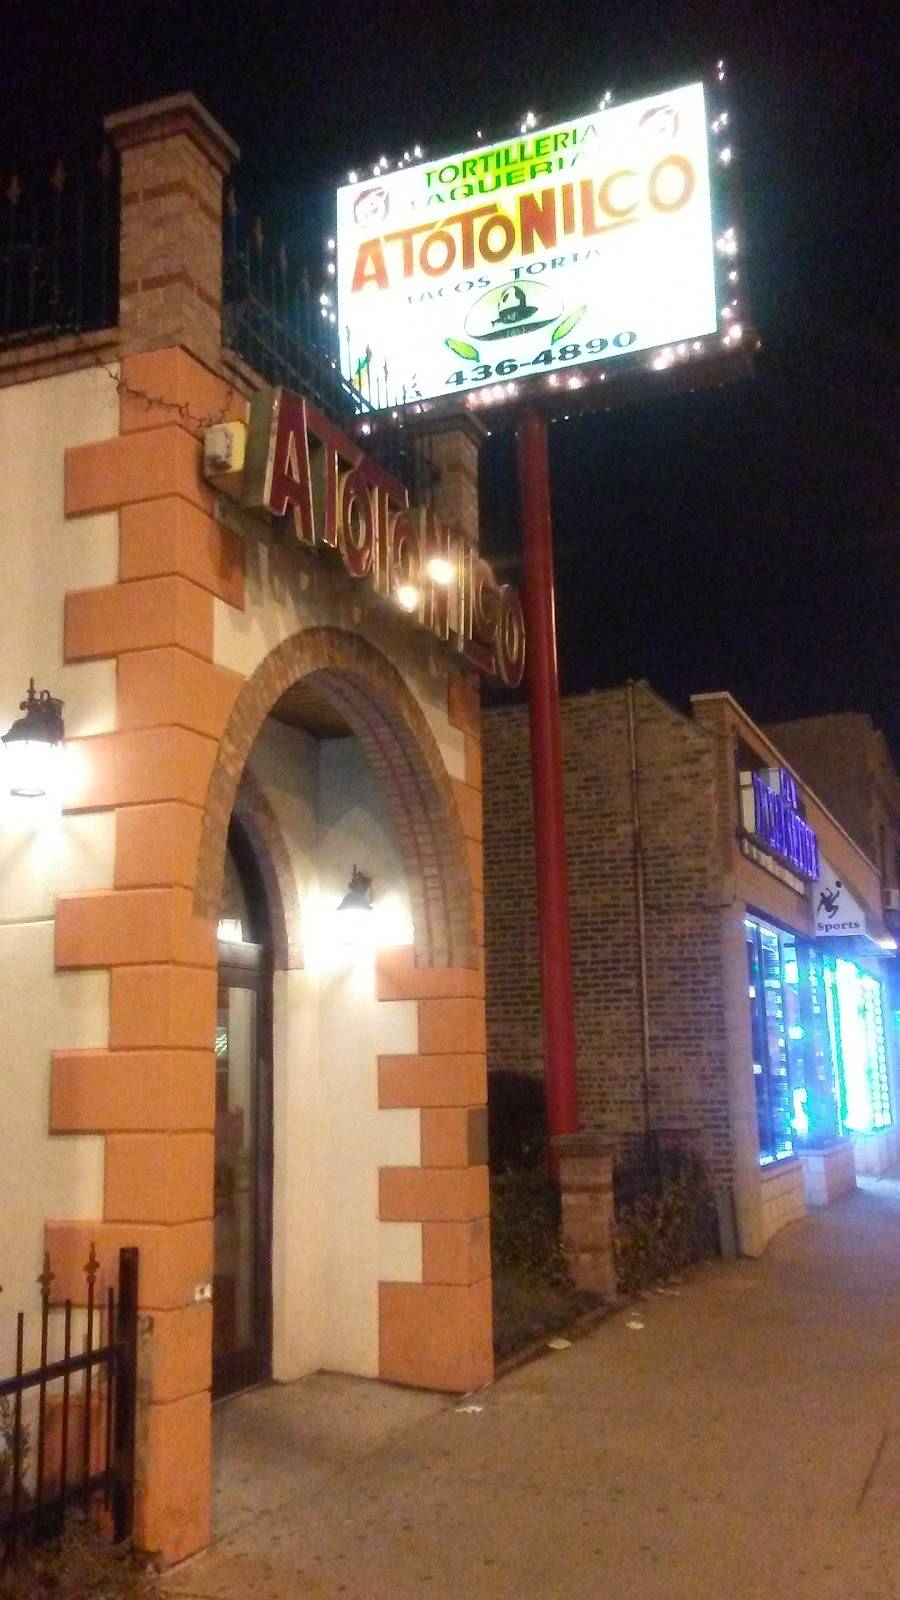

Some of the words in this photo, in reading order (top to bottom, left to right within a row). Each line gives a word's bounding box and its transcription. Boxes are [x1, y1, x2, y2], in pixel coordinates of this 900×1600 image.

[425, 124, 597, 188] TORTILLERIA
[407, 275, 492, 305] TACOS
[444, 331, 638, 387] 436-4890
[816, 921, 861, 933] Sports
